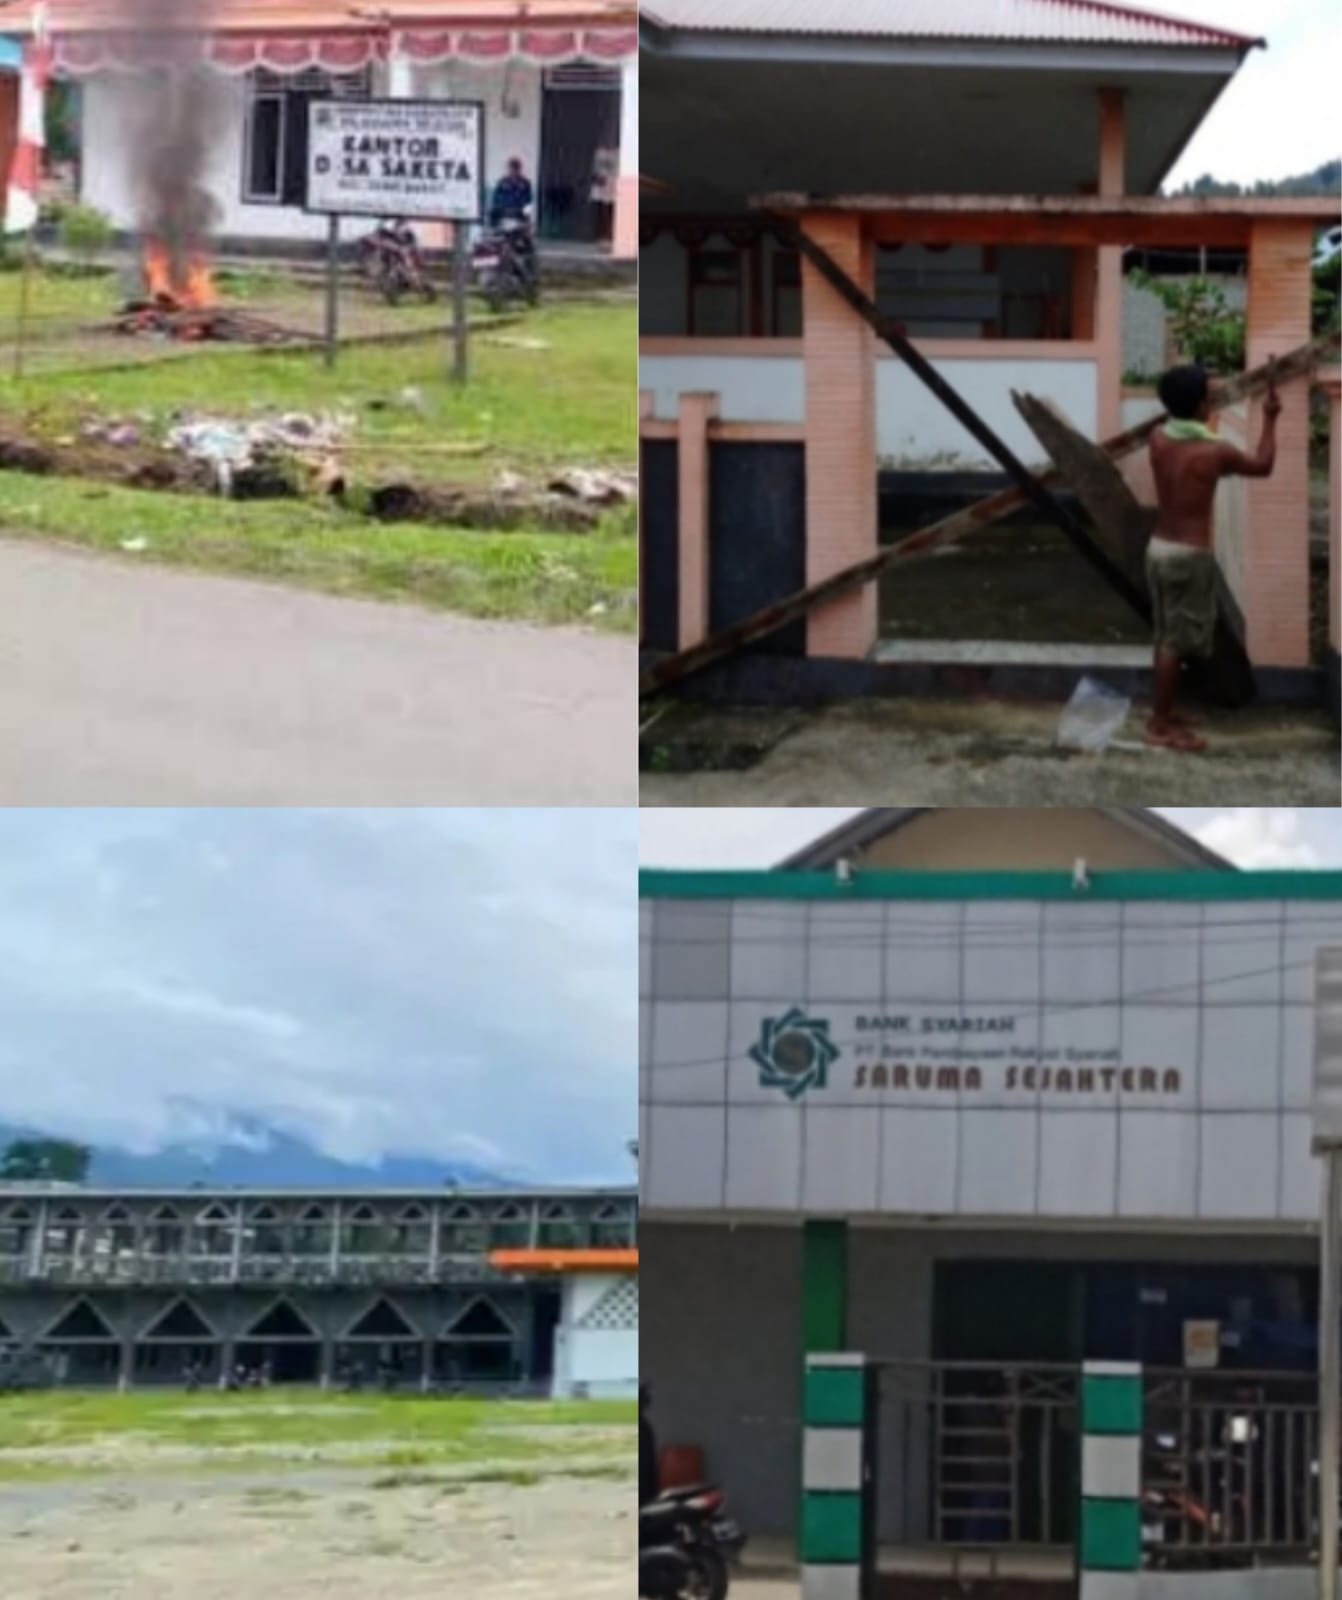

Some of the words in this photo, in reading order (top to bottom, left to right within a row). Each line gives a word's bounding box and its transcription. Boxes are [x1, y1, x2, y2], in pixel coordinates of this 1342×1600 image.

[343, 136, 439, 158] KANTOR
[381, 160, 470, 181] SAKETA
[855, 1016, 909, 1032] BANK
[921, 1016, 1015, 1033] SYARIAH
[854, 1064, 982, 1091] SARUMA
[1004, 1065, 1181, 1093] SEJAHTERA
